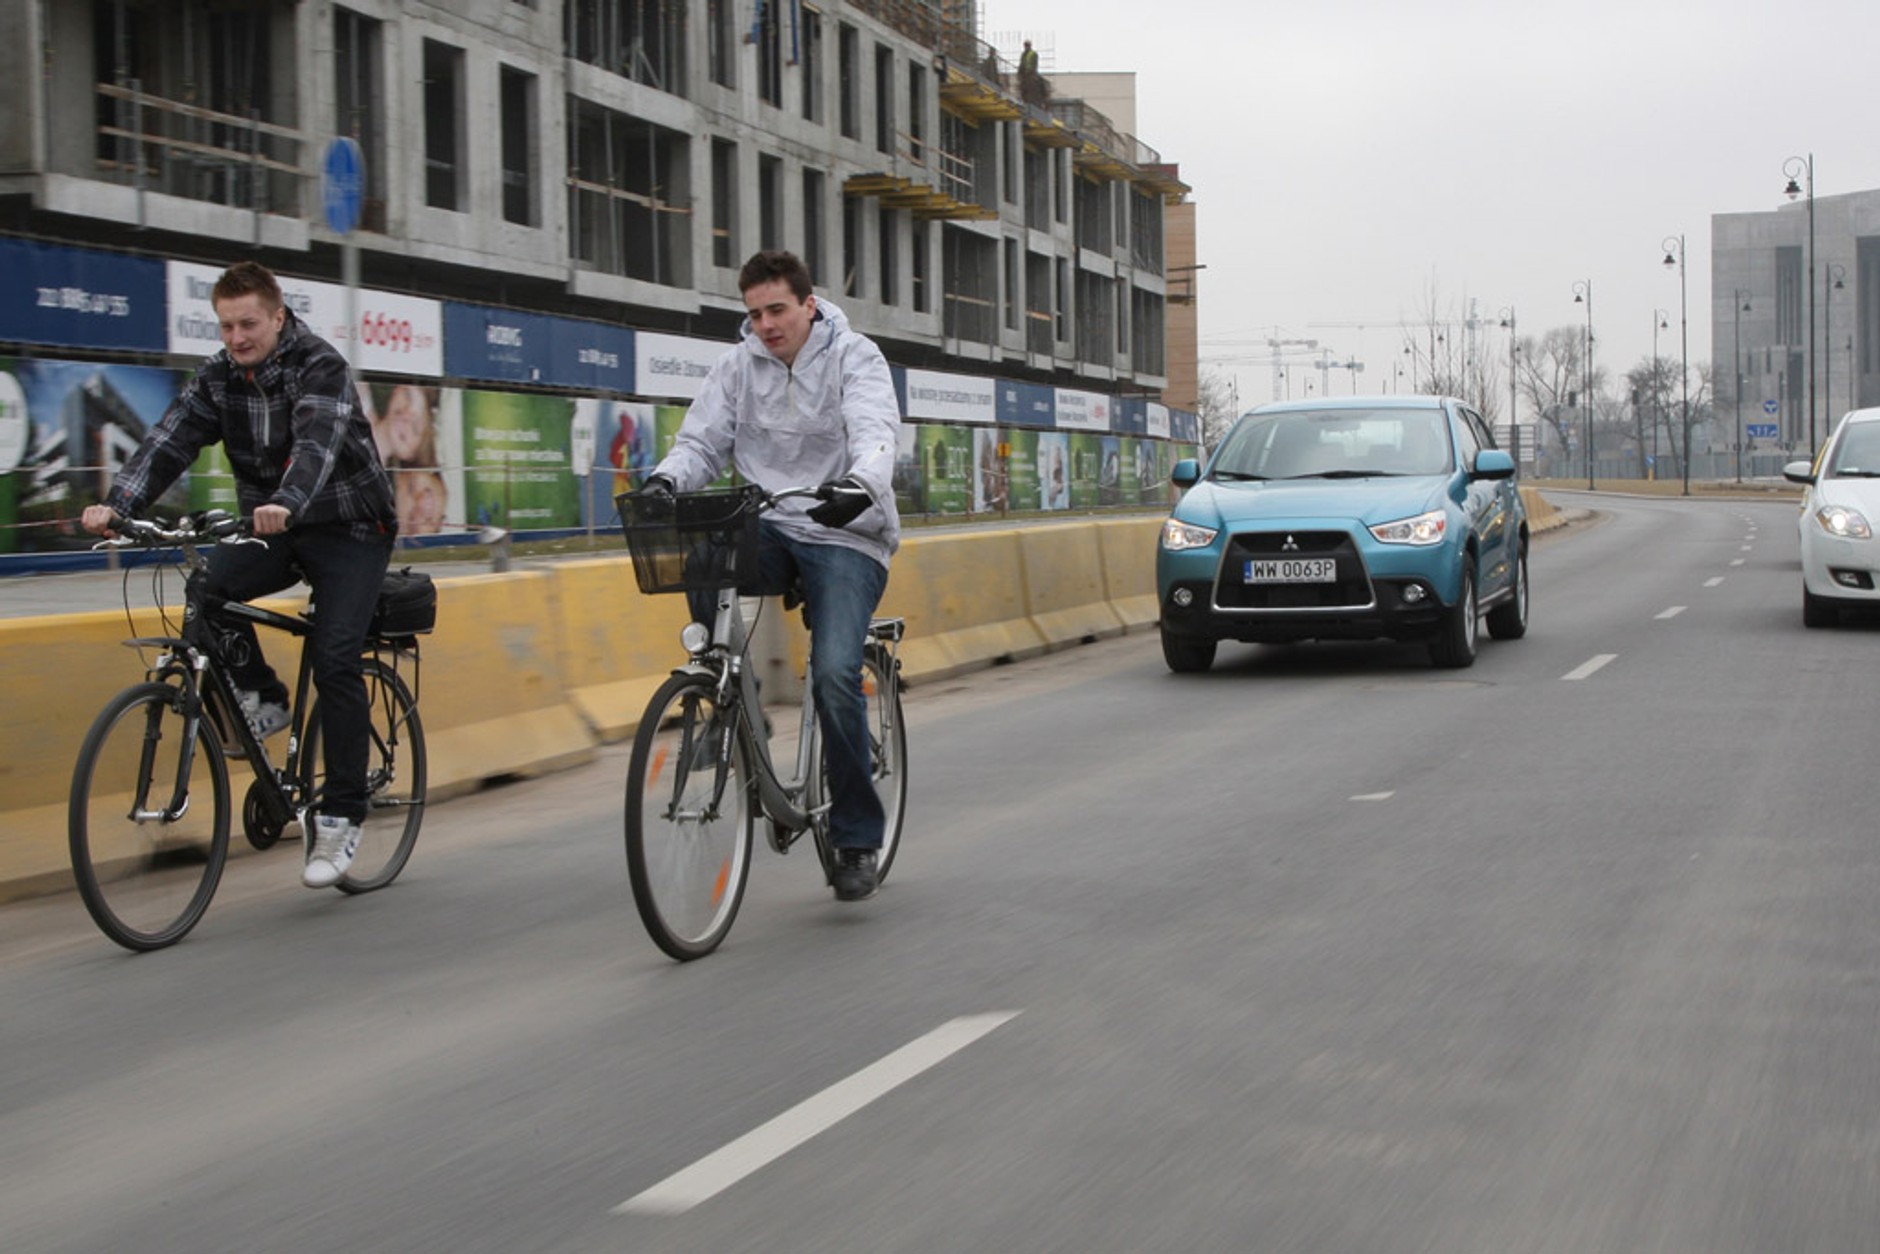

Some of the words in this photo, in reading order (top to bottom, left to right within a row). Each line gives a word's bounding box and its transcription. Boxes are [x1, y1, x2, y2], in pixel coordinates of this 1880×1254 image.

[361, 310, 413, 353] 6699
[1254, 562, 1277, 578] WW
[1283, 561, 1334, 578] 0063P
